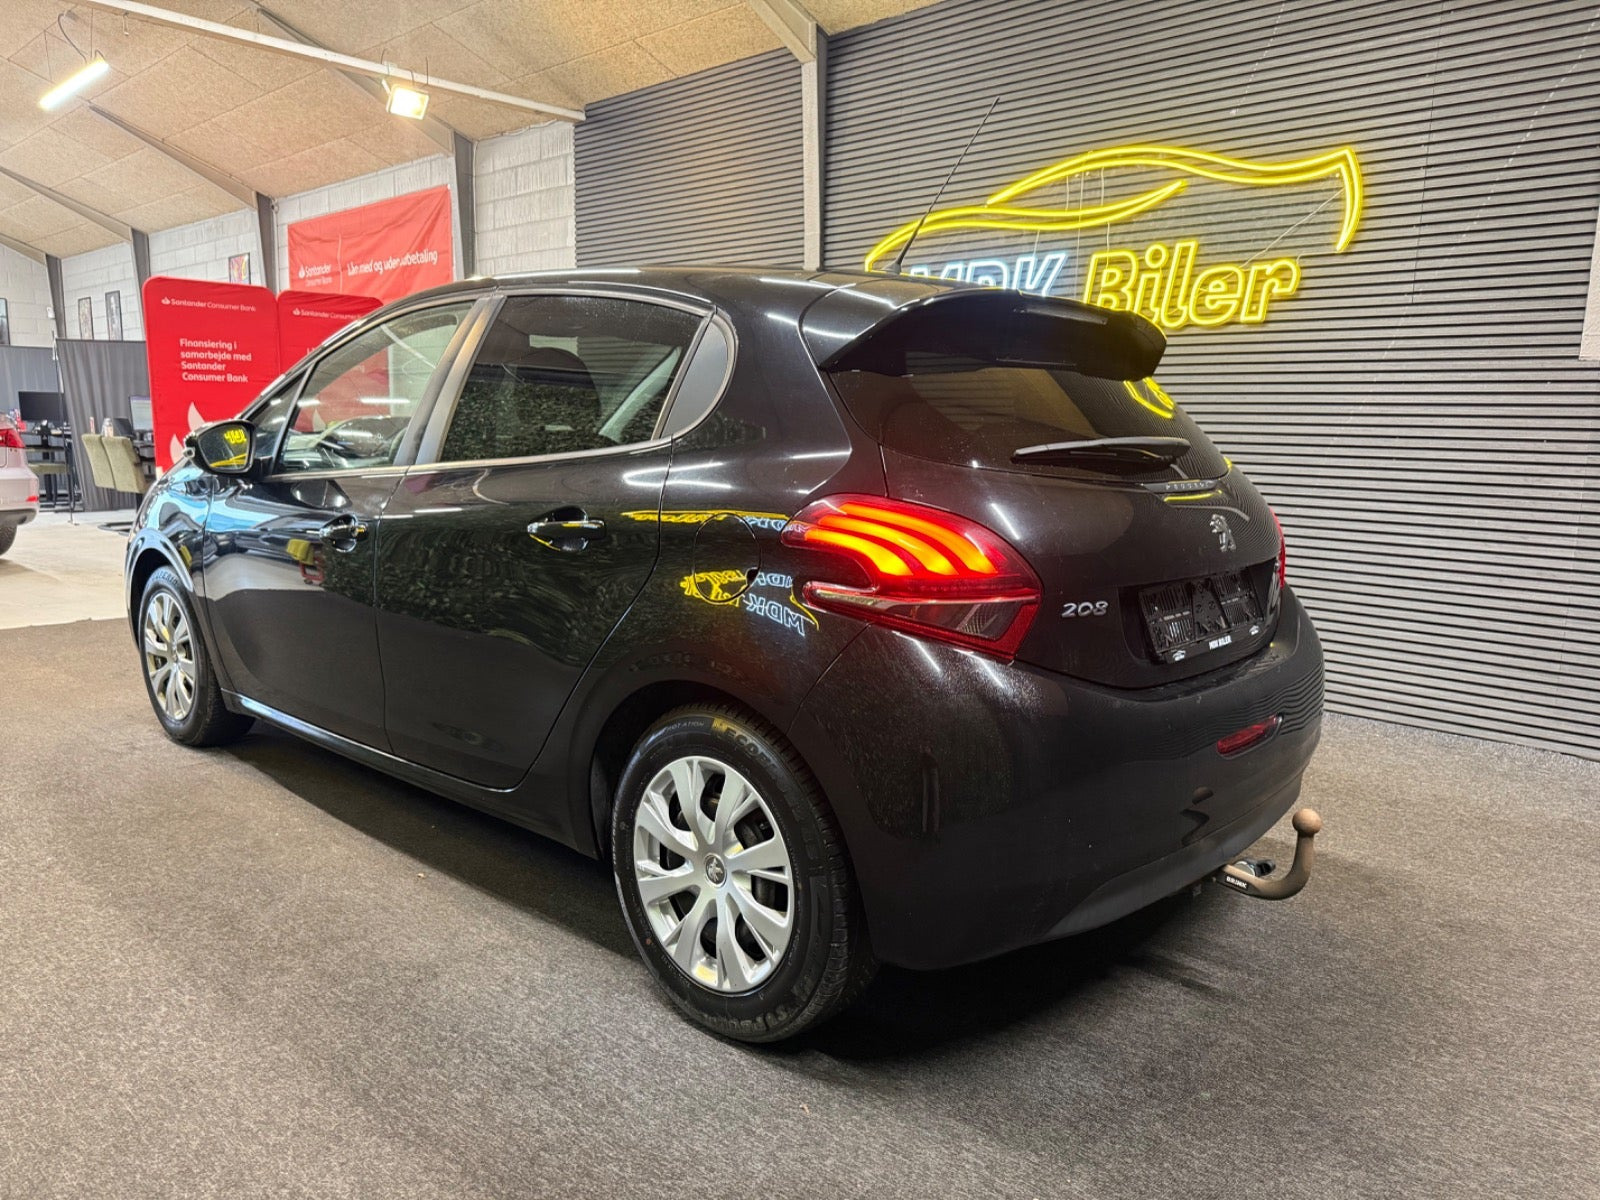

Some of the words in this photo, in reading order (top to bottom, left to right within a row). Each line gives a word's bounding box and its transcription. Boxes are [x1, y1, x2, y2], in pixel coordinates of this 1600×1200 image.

[305, 264, 332, 278] Santander
[373, 261, 384, 275] og
[1084, 241, 1301, 328] Biler
[171, 298, 206, 308] Santander
[207, 301, 239, 311] Consumer
[240, 304, 256, 312] Bank
[300, 309, 329, 319] Santander
[179, 338, 233, 351] Finansiering
[180, 350, 232, 362] samarbejde
[233, 352, 252, 361] med
[181, 361, 226, 371] Santander
[182, 371, 226, 382] Consumer
[226, 373, 249, 383] Bank
[1061, 600, 1109, 618] 208
